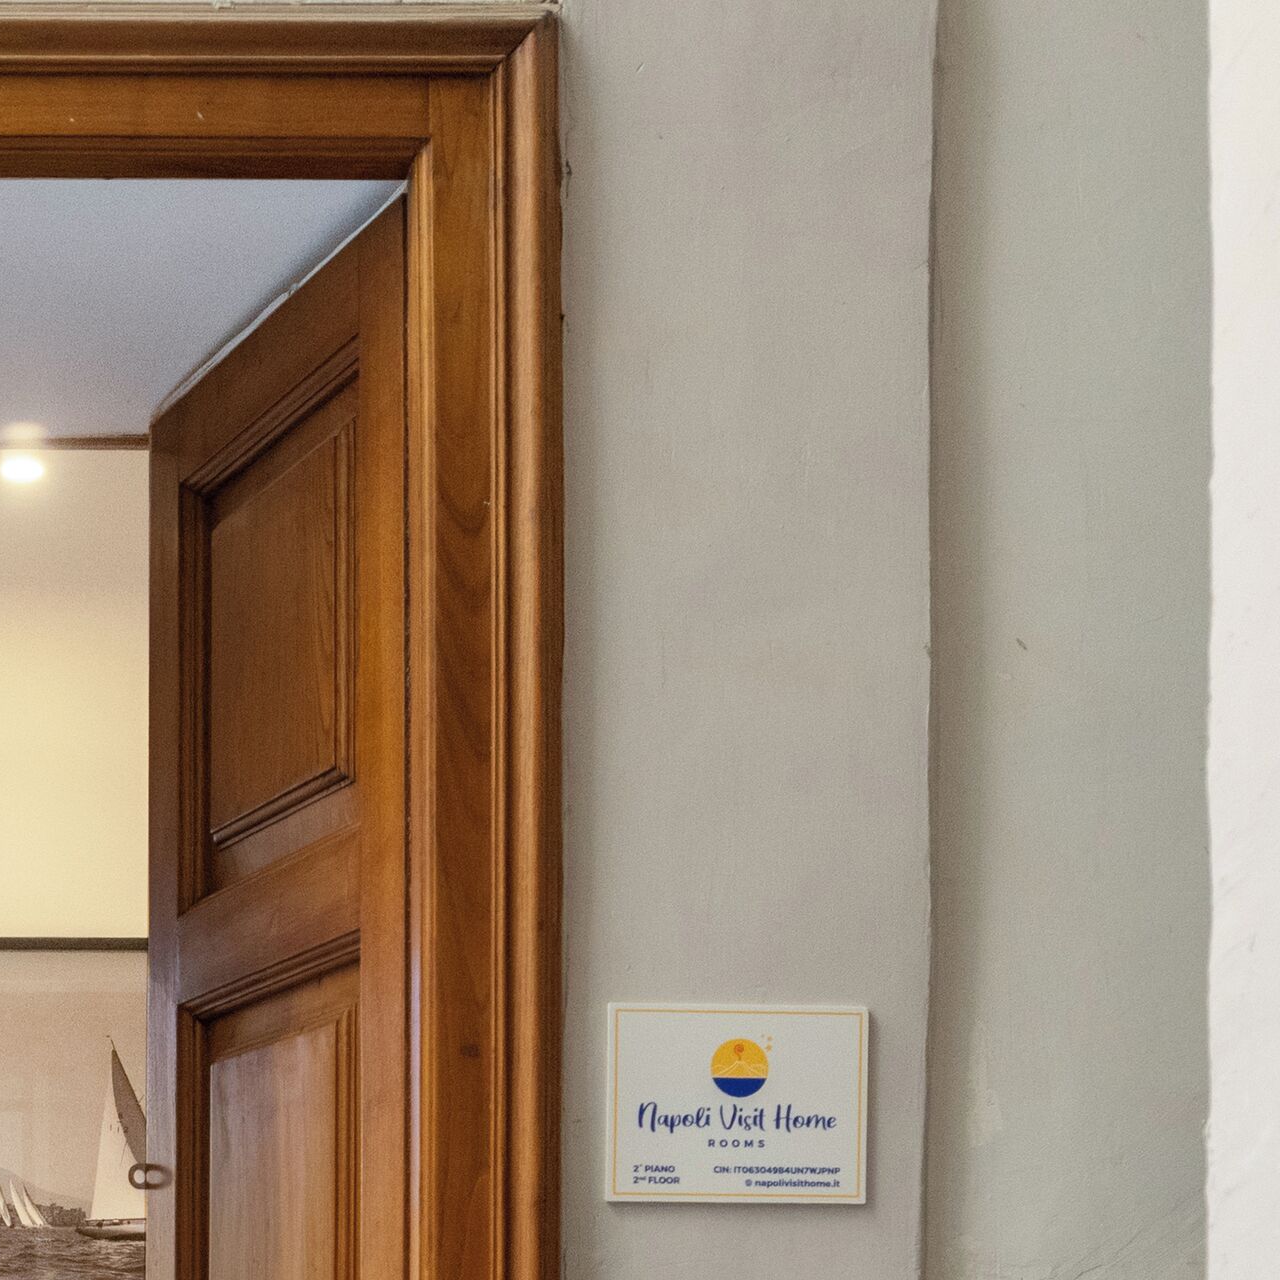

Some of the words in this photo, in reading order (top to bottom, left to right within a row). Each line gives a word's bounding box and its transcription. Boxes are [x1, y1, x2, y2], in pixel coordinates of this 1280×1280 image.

[638, 1101, 712, 1134] Napoli
[719, 1103, 767, 1132] Visit
[772, 1103, 837, 1133] Home
[707, 1138, 766, 1148] ROOMS
[644, 1165, 675, 1173] PIANO
[713, 1165, 732, 1174] CIN:
[648, 1176, 681, 1185] FLOOR
[755, 1179, 841, 1188] napolivisithome.it
